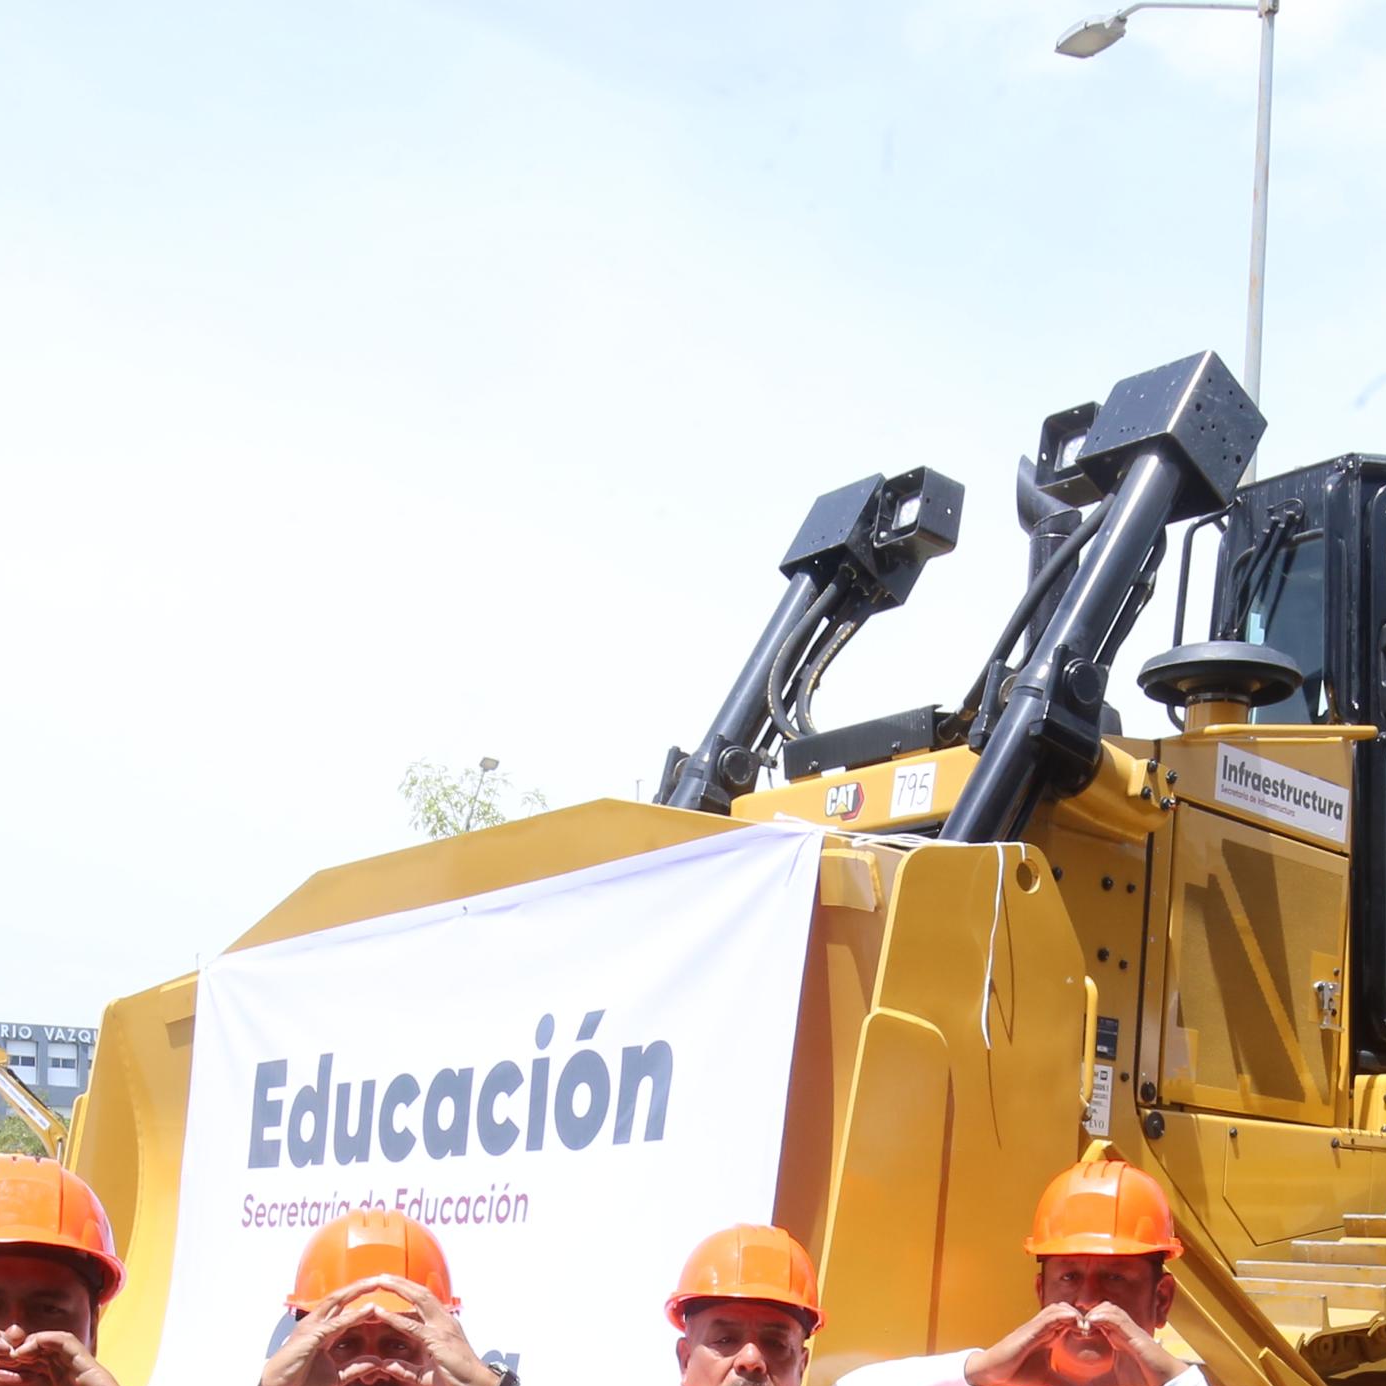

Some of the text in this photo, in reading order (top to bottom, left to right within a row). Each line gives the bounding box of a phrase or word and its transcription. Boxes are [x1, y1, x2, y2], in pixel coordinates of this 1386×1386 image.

[826, 783, 858, 817] CAT
[897, 773, 930, 808] 795
[1222, 755, 1343, 820] Infraestructura
[44, 1027, 98, 1043] VAZQ
[247, 1009, 674, 1169] Educación
[395, 1182, 529, 1226] Educación
